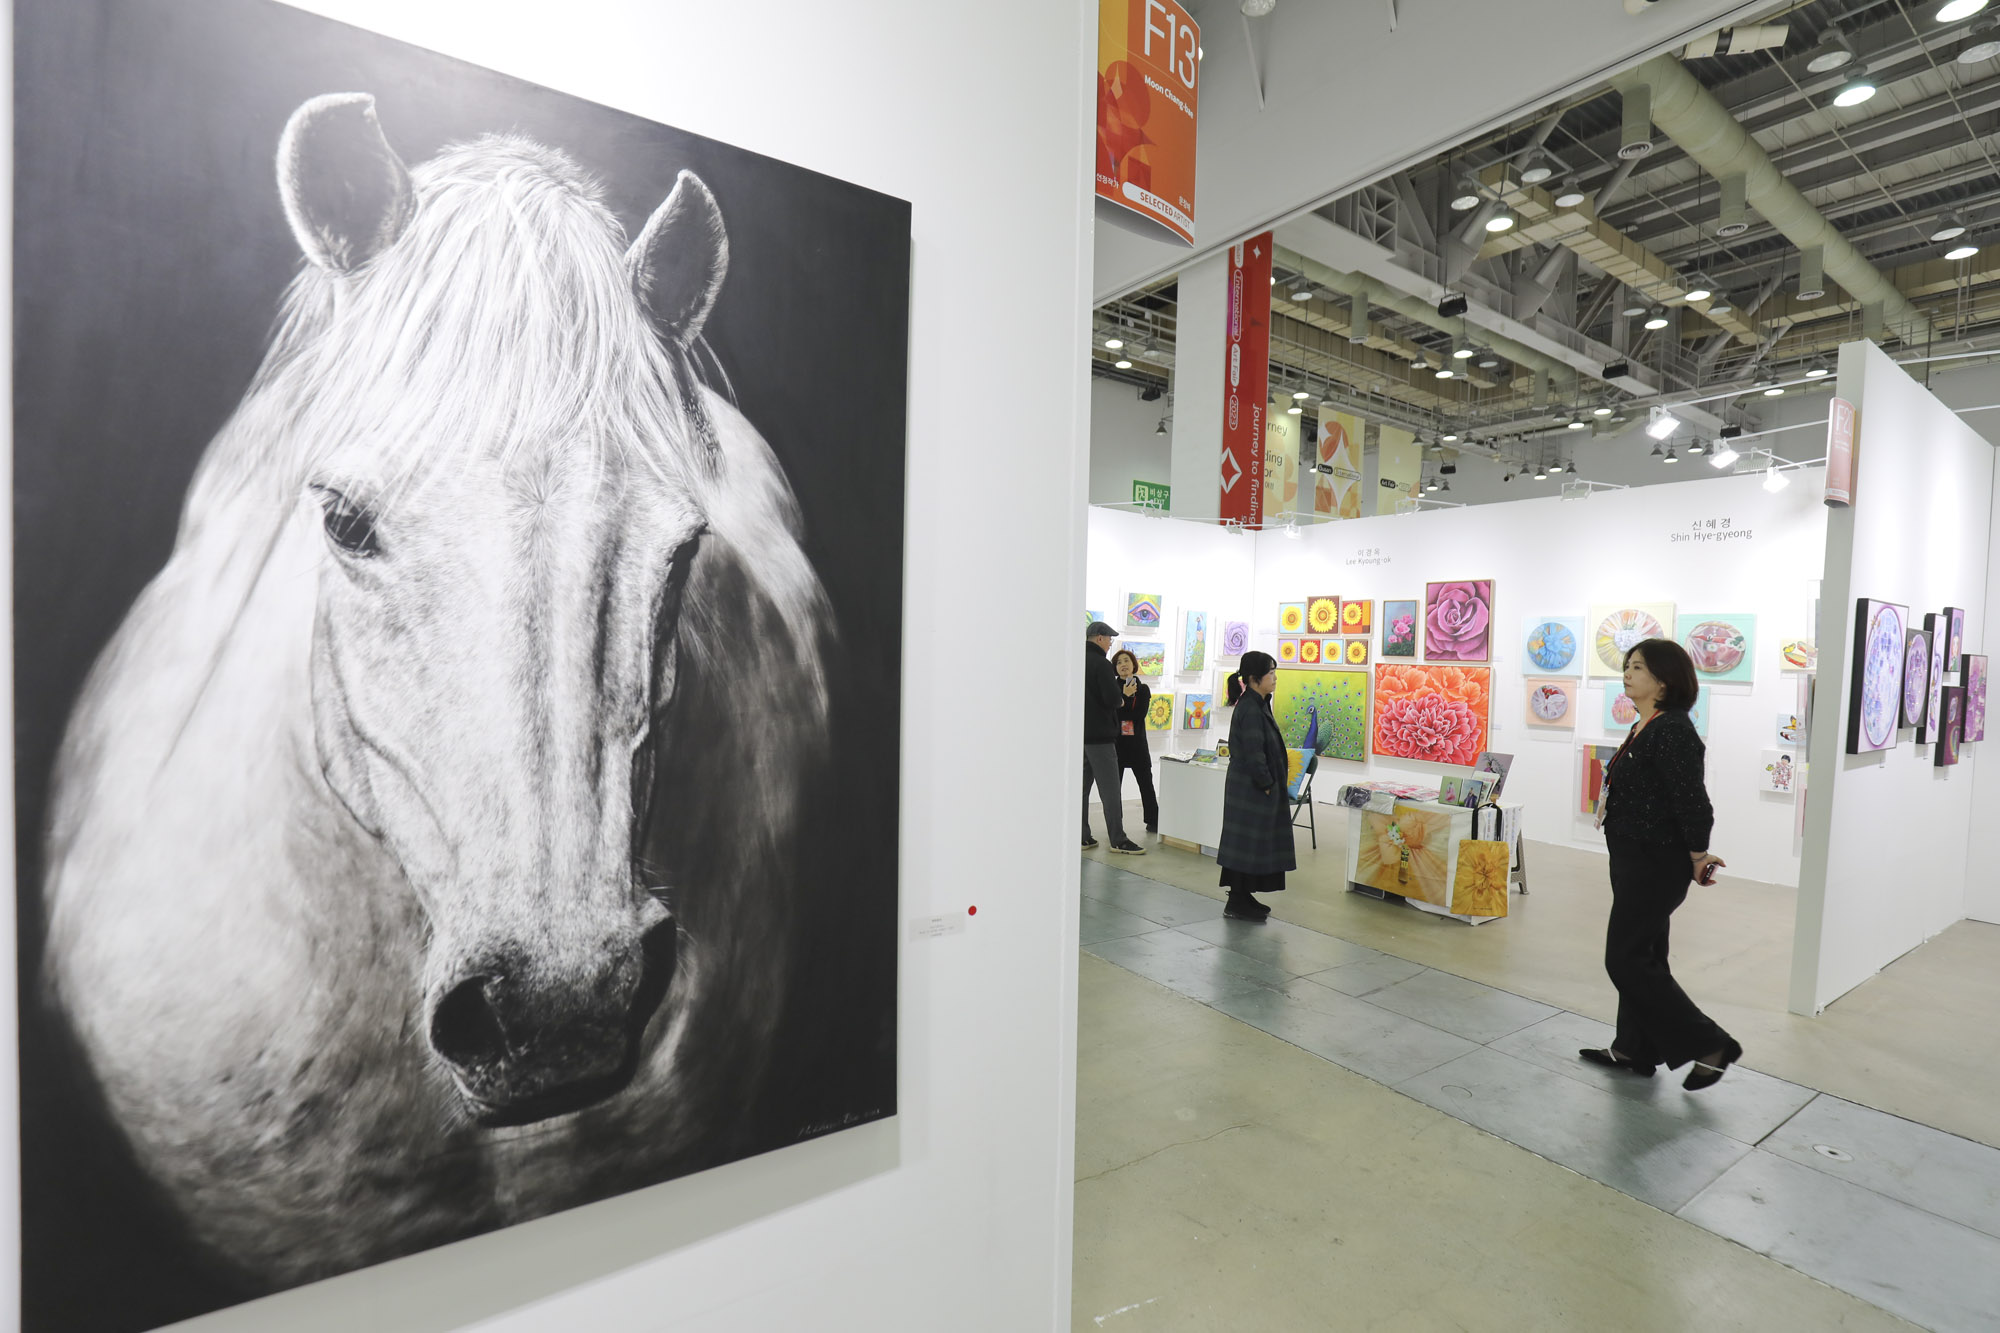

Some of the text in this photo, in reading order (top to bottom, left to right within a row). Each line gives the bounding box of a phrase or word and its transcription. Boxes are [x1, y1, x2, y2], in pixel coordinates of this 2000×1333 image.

[1144, 0, 1196, 89] F13
[1144, 74, 1194, 119] Moon Chang-bae
[1140, 191, 1190, 229] SELECTED ARTIST
[1249, 403, 1262, 524] journey to finding
[1150, 488, 1169, 499] 비상구
[1670, 529, 1753, 542] Shin Hye-gyeong
